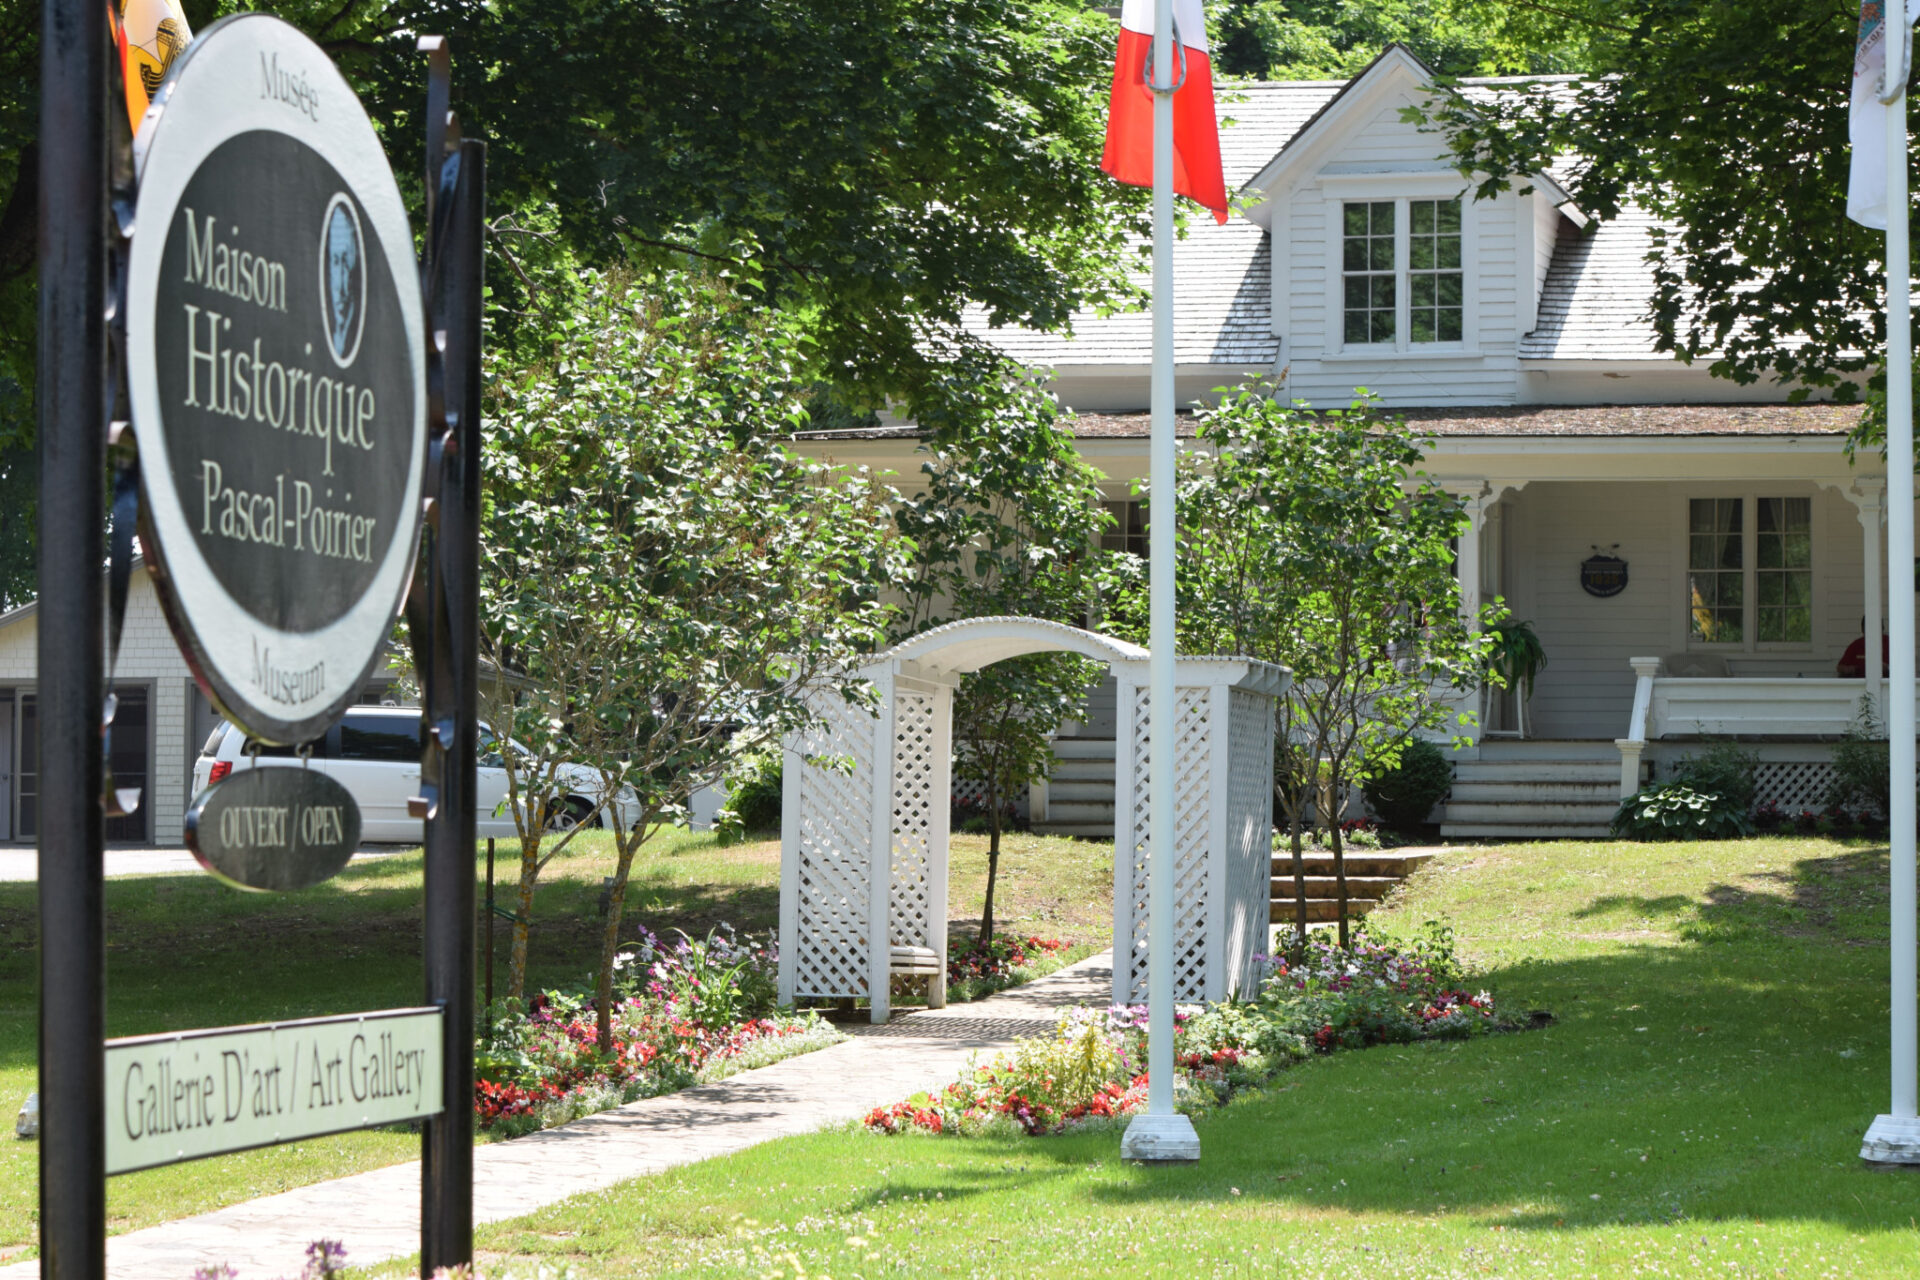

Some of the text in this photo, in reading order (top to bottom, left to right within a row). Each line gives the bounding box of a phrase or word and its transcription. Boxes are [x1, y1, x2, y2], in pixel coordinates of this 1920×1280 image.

[260, 51, 319, 122] Musée
[184, 207, 288, 313] Maison
[184, 304, 375, 476] Historique
[201, 459, 375, 563] Pascal-Poirier
[252, 634, 325, 704] Museum
[219, 806, 288, 849] OUVERT
[302, 806, 344, 846] OPEN
[124, 1053, 214, 1141] Gallerie
[308, 1041, 342, 1109] Art
[350, 1032, 425, 1110] Gallery
